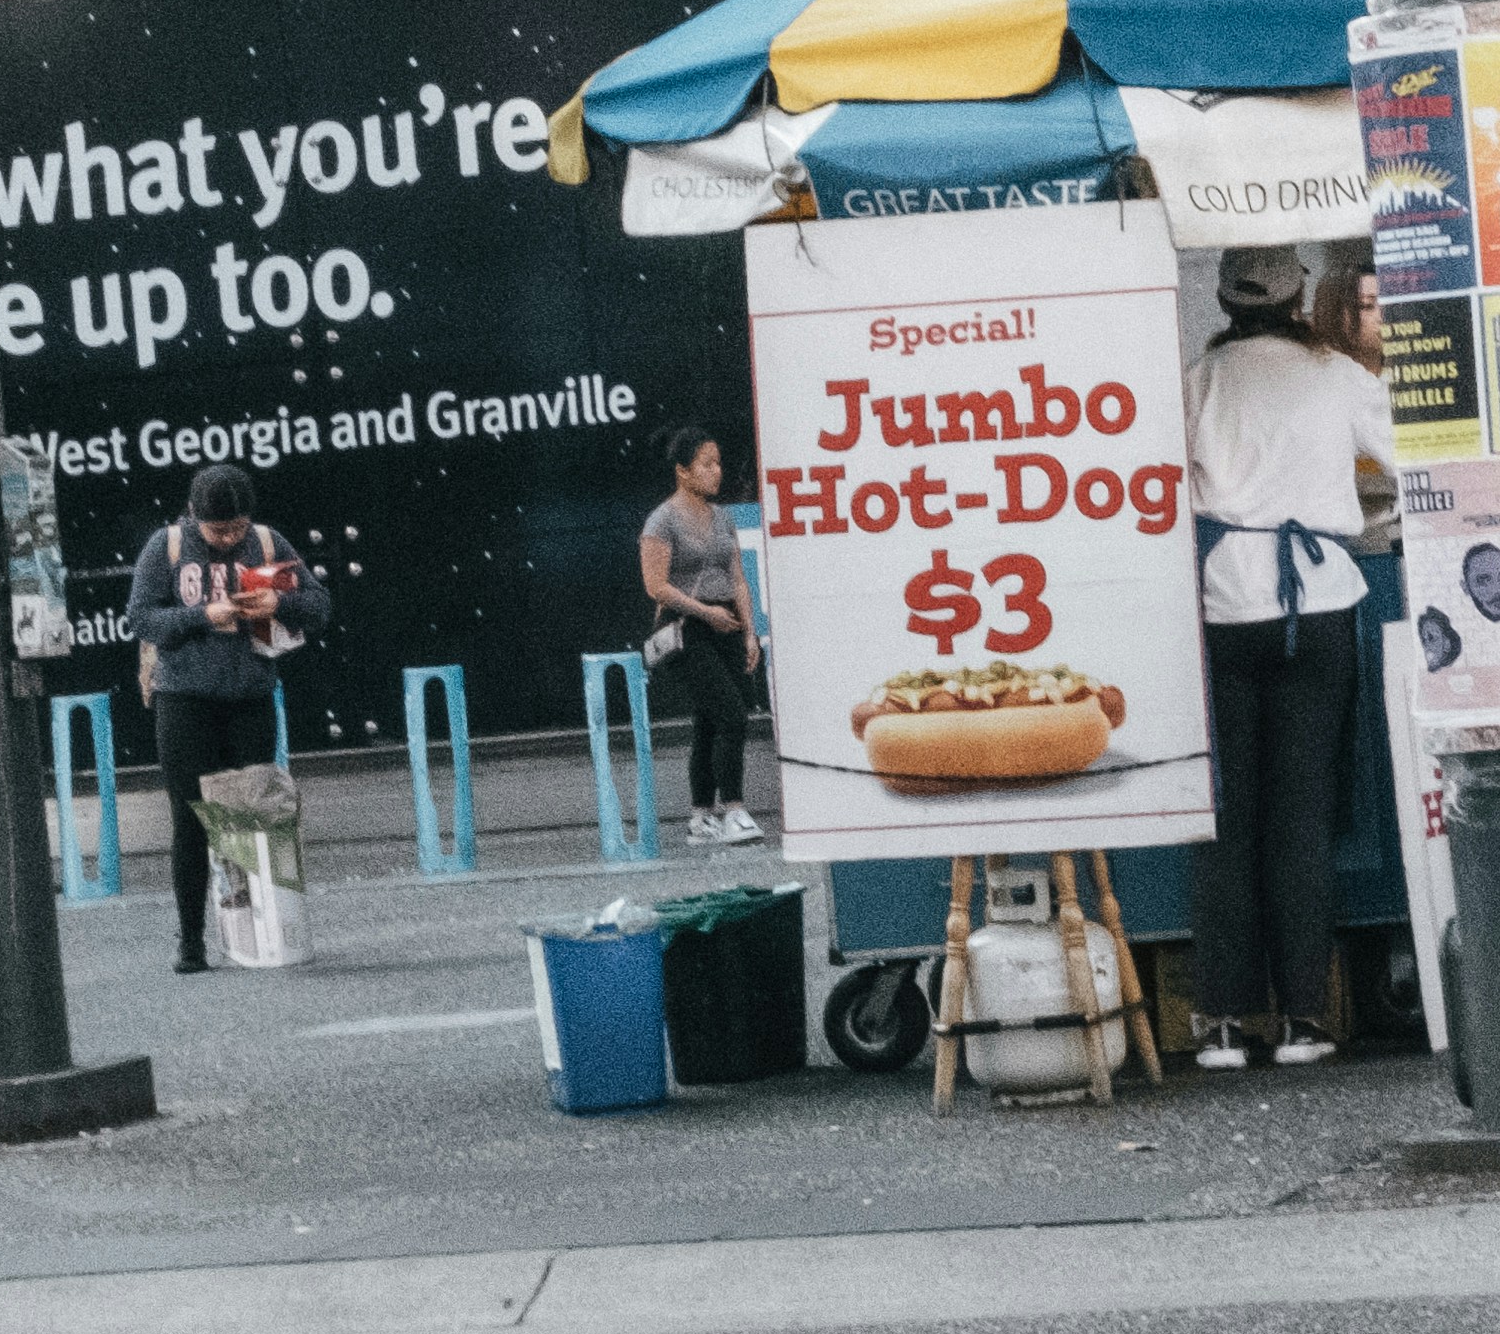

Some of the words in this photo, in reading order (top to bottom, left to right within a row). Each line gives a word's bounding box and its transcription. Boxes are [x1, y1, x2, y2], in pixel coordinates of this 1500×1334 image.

[238, 83, 549, 229] you're
[843, 187, 970, 217] GREAT
[977, 178, 1097, 209] TASTE
[1188, 182, 1267, 213] COLD
[71, 267, 188, 369] up
[211, 241, 394, 333] too.
[869, 308, 1037, 355] Special!
[139, 405, 321, 468] Georgia
[330, 391, 415, 450] and
[426, 373, 638, 441] Granville
[817, 363, 1137, 451] Jumbo
[766, 452, 1184, 537] Hot-Dog
[904, 549, 1053, 655] $3
